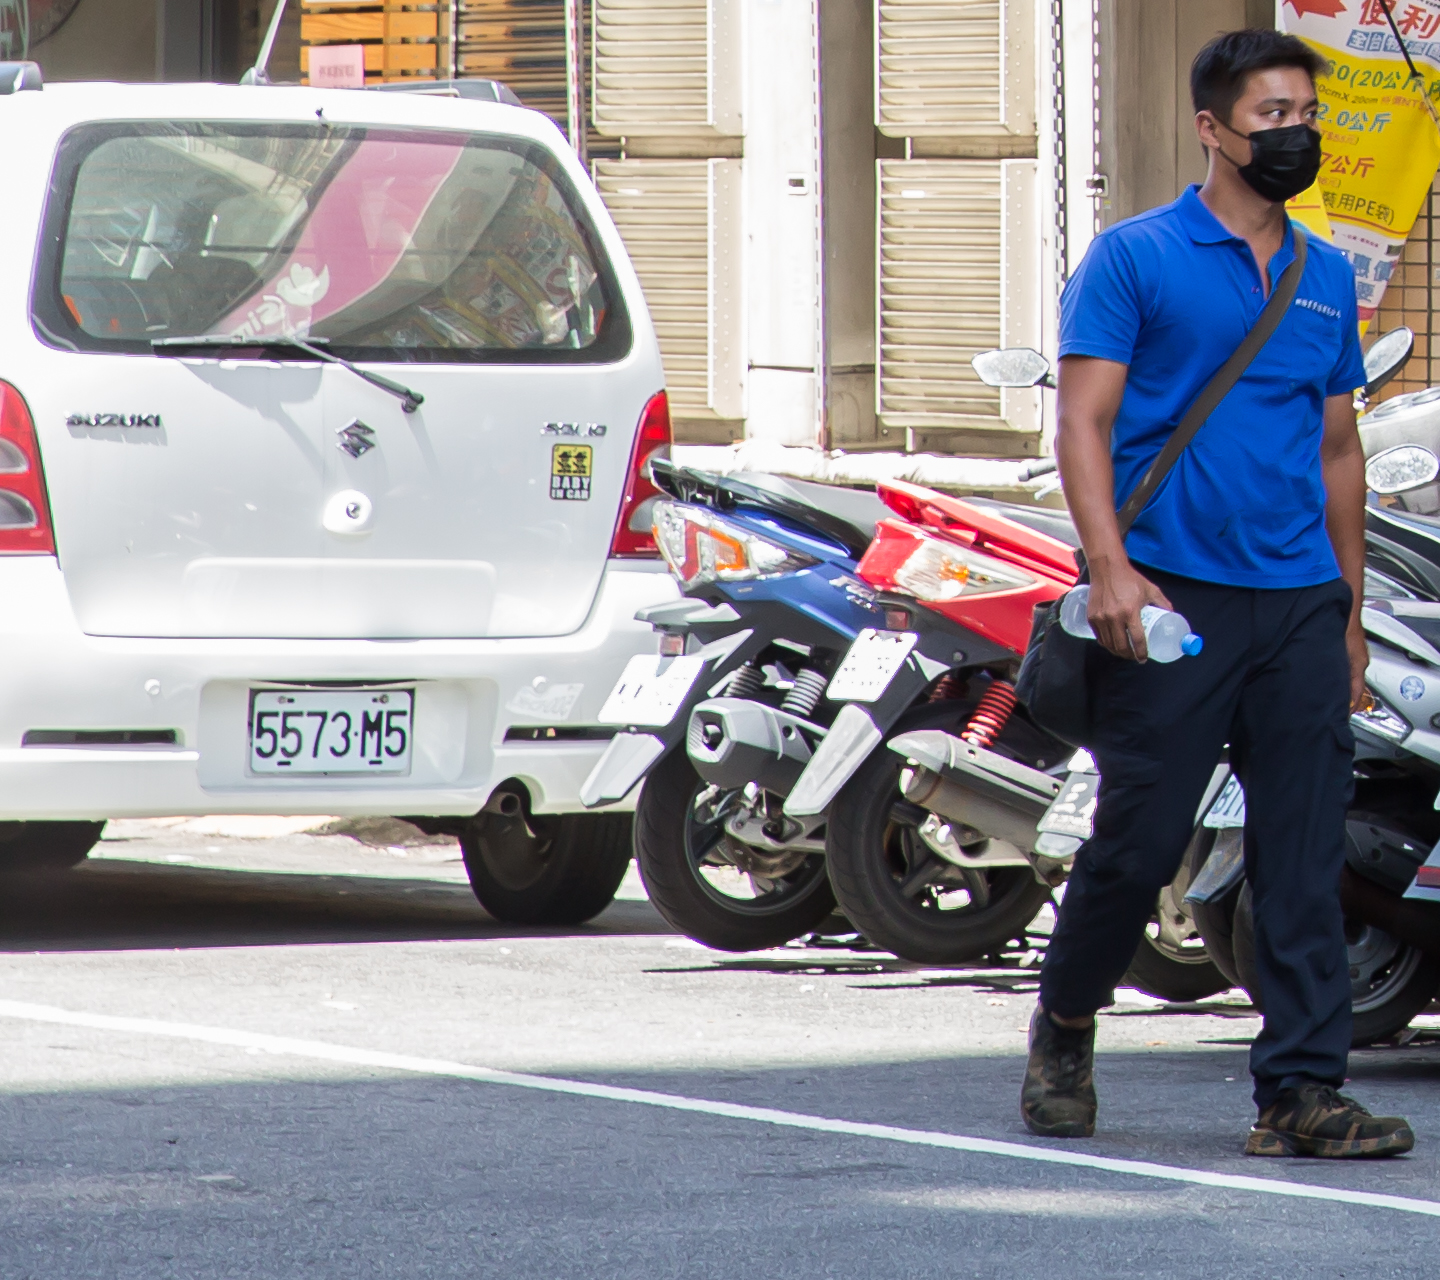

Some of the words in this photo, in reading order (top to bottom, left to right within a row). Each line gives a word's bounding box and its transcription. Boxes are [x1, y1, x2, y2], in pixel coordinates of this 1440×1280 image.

[65, 412, 162, 428] SUZUKI
[550, 476, 591, 489] BABY
[551, 488, 563, 500] IN
[565, 488, 590, 500] CAR
